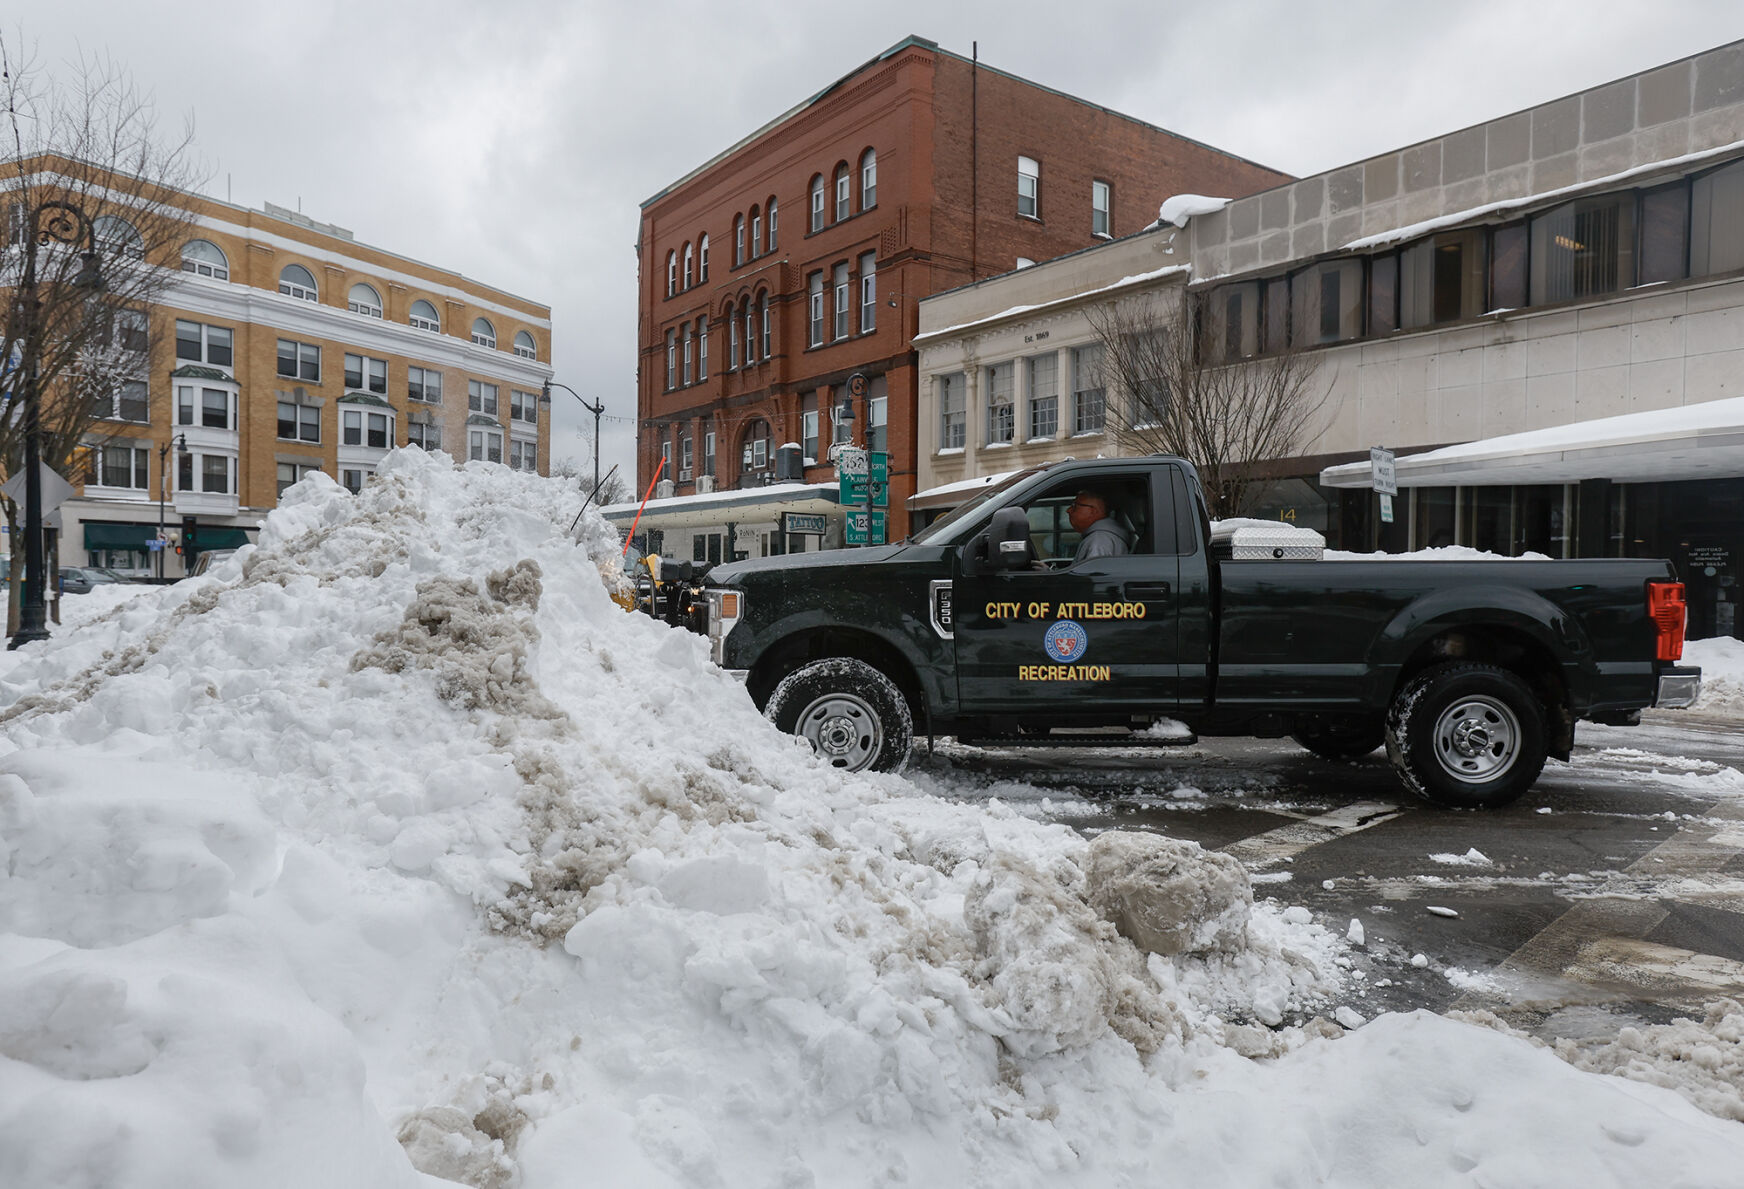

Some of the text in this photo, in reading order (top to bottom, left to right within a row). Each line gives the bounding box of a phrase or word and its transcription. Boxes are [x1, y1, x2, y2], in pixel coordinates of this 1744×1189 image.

[1378, 466, 1390, 476] MUST
[788, 515, 824, 529] TATTOO
[1280, 509, 1296, 522] 14
[985, 602, 1146, 619] CITY OF ATTLEBORO
[1019, 665, 1111, 681] RECREATION
